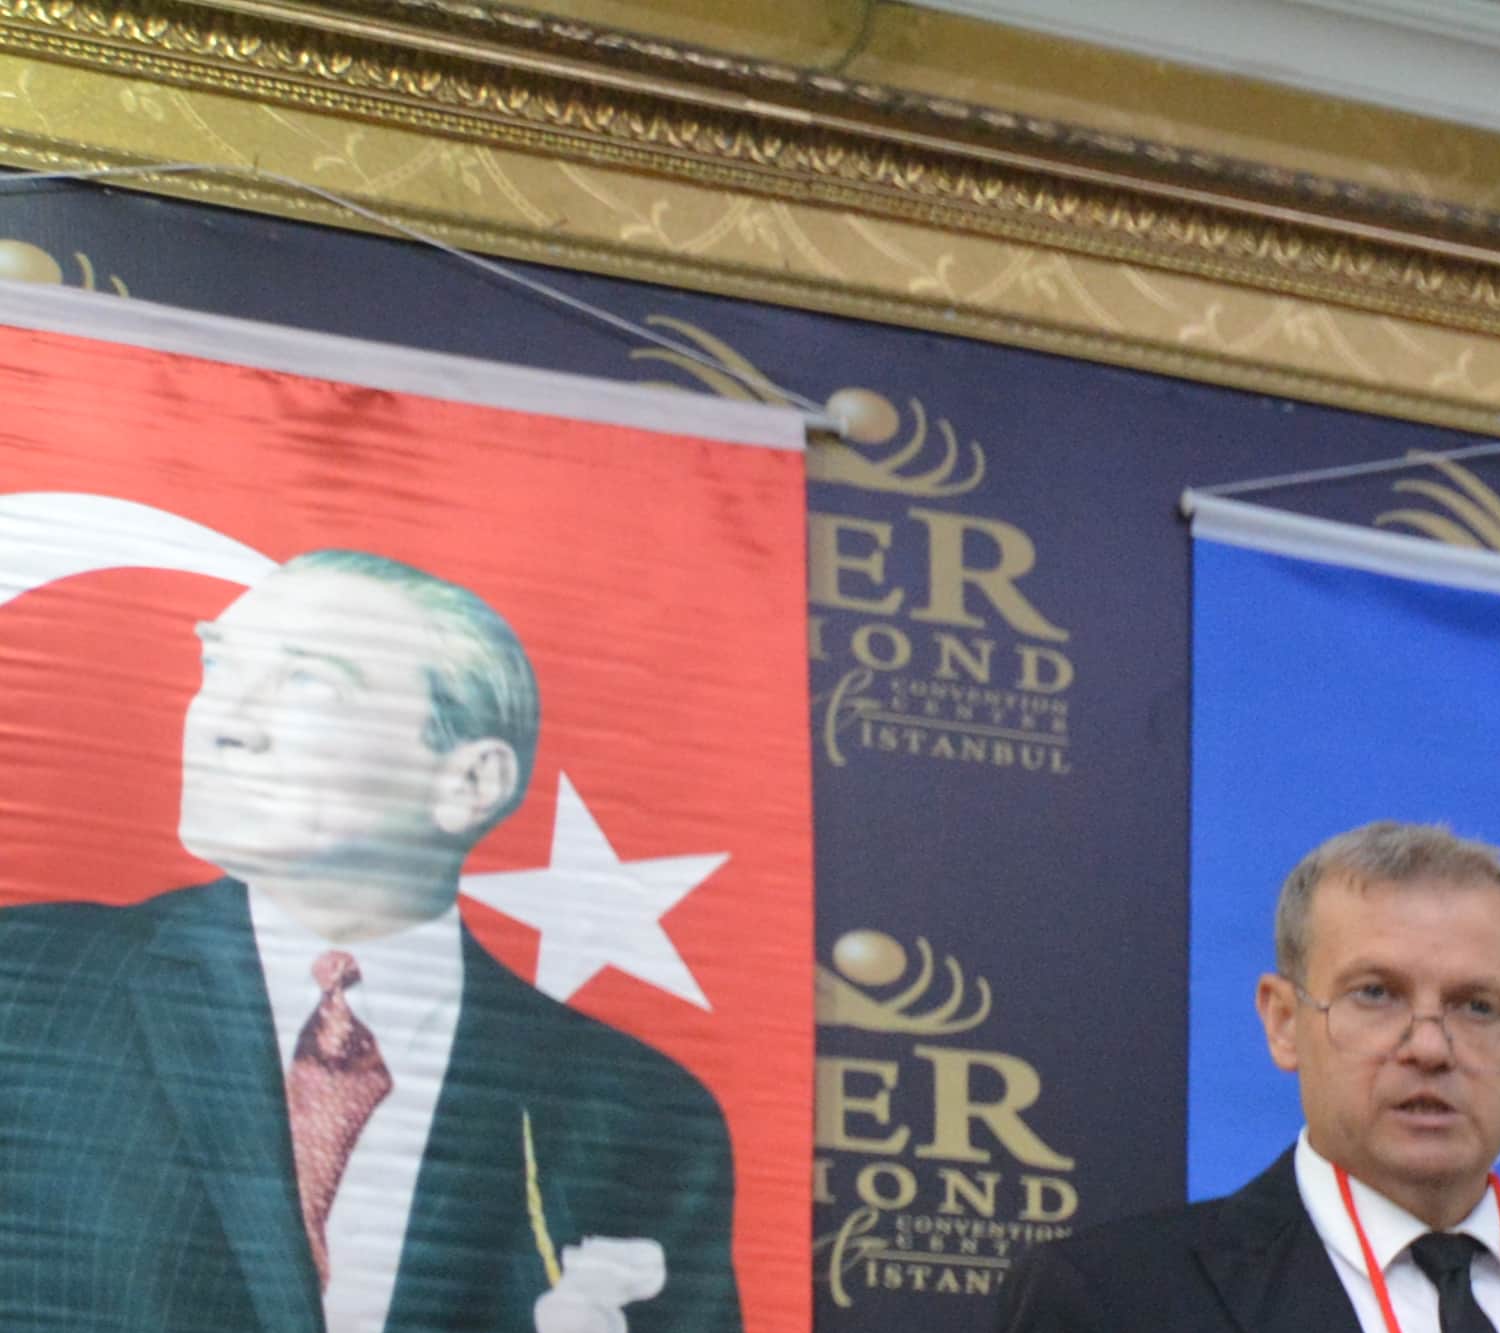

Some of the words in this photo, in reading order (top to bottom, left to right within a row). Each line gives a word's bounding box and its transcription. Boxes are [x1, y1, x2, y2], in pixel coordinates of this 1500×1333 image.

[808, 506, 1070, 643] ER
[814, 1044, 1076, 1172] ER
[866, 1258, 1004, 1296] ISTAN
[896, 1233, 1010, 1257] CENT
